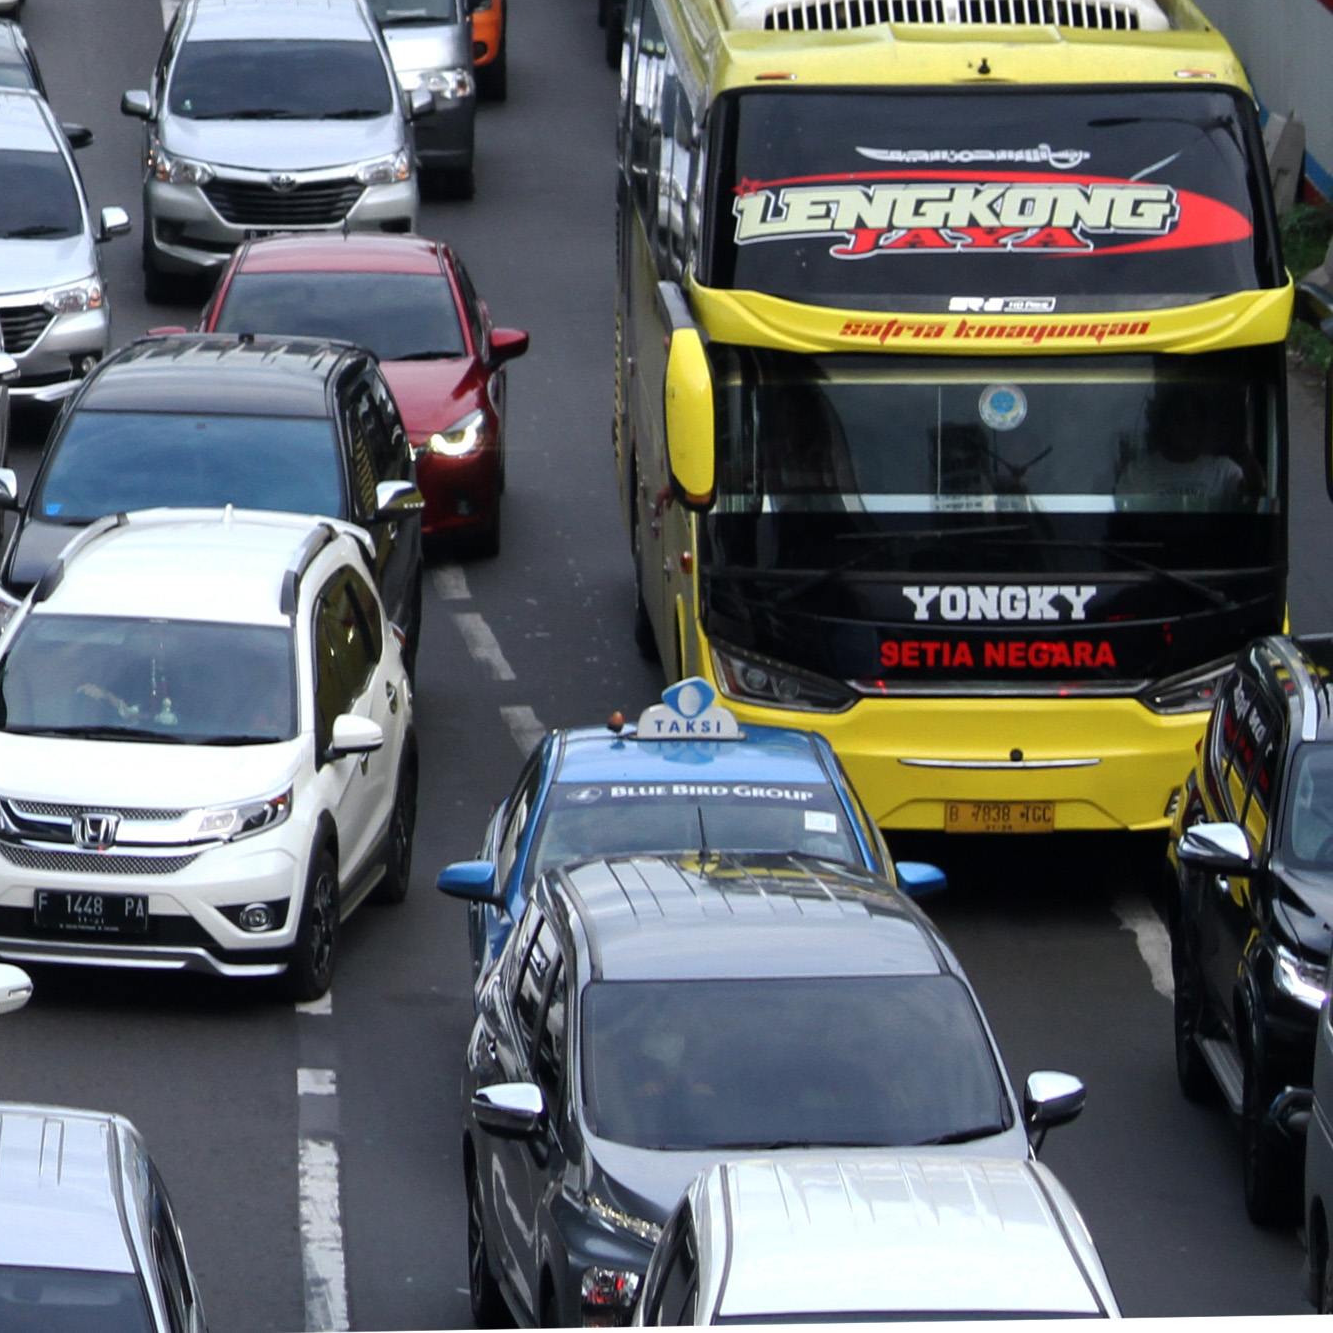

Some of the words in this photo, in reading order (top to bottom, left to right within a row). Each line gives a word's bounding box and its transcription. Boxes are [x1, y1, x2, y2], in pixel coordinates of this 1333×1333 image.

[734, 184, 1180, 244] LENGKONG
[902, 585, 1097, 621] YONGKY
[880, 640, 975, 668] SETIA
[983, 640, 1117, 668] NEGARA
[654, 719, 721, 734] TAKSI
[38, 892, 48, 912] F
[65, 893, 103, 915] 1448
[124, 897, 145, 918] PA
